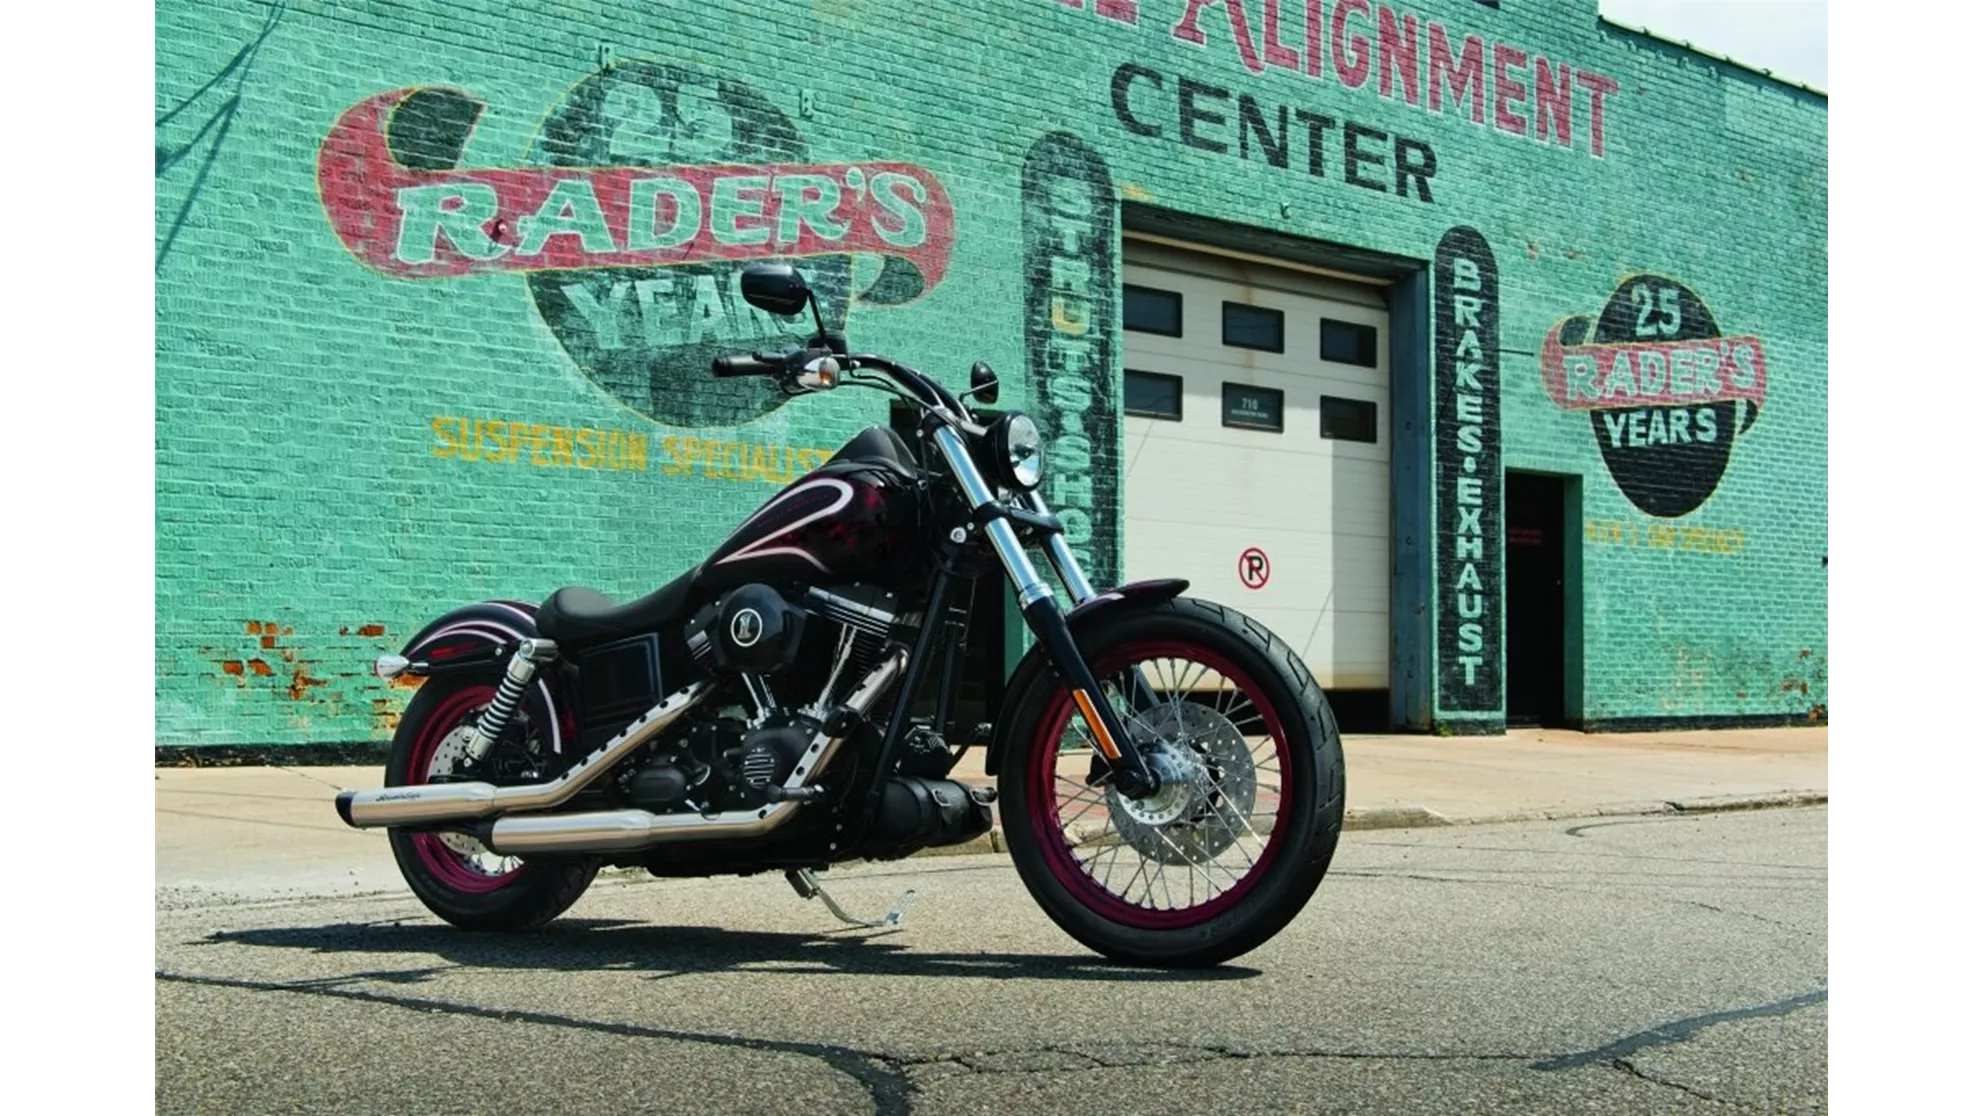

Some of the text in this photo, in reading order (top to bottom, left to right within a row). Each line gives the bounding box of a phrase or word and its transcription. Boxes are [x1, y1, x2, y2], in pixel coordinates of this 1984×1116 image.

[602, 82, 734, 155] 25
[1111, 62, 1438, 204] CENTER
[396, 166, 928, 264] RADER'S
[1632, 282, 1682, 337] 25
[1562, 341, 1756, 400] RADER'S
[430, 416, 647, 472] SUSPENSION
[1603, 407, 1718, 447] YEARS
[1453, 257, 1484, 686] BRAKES EXHAUST
